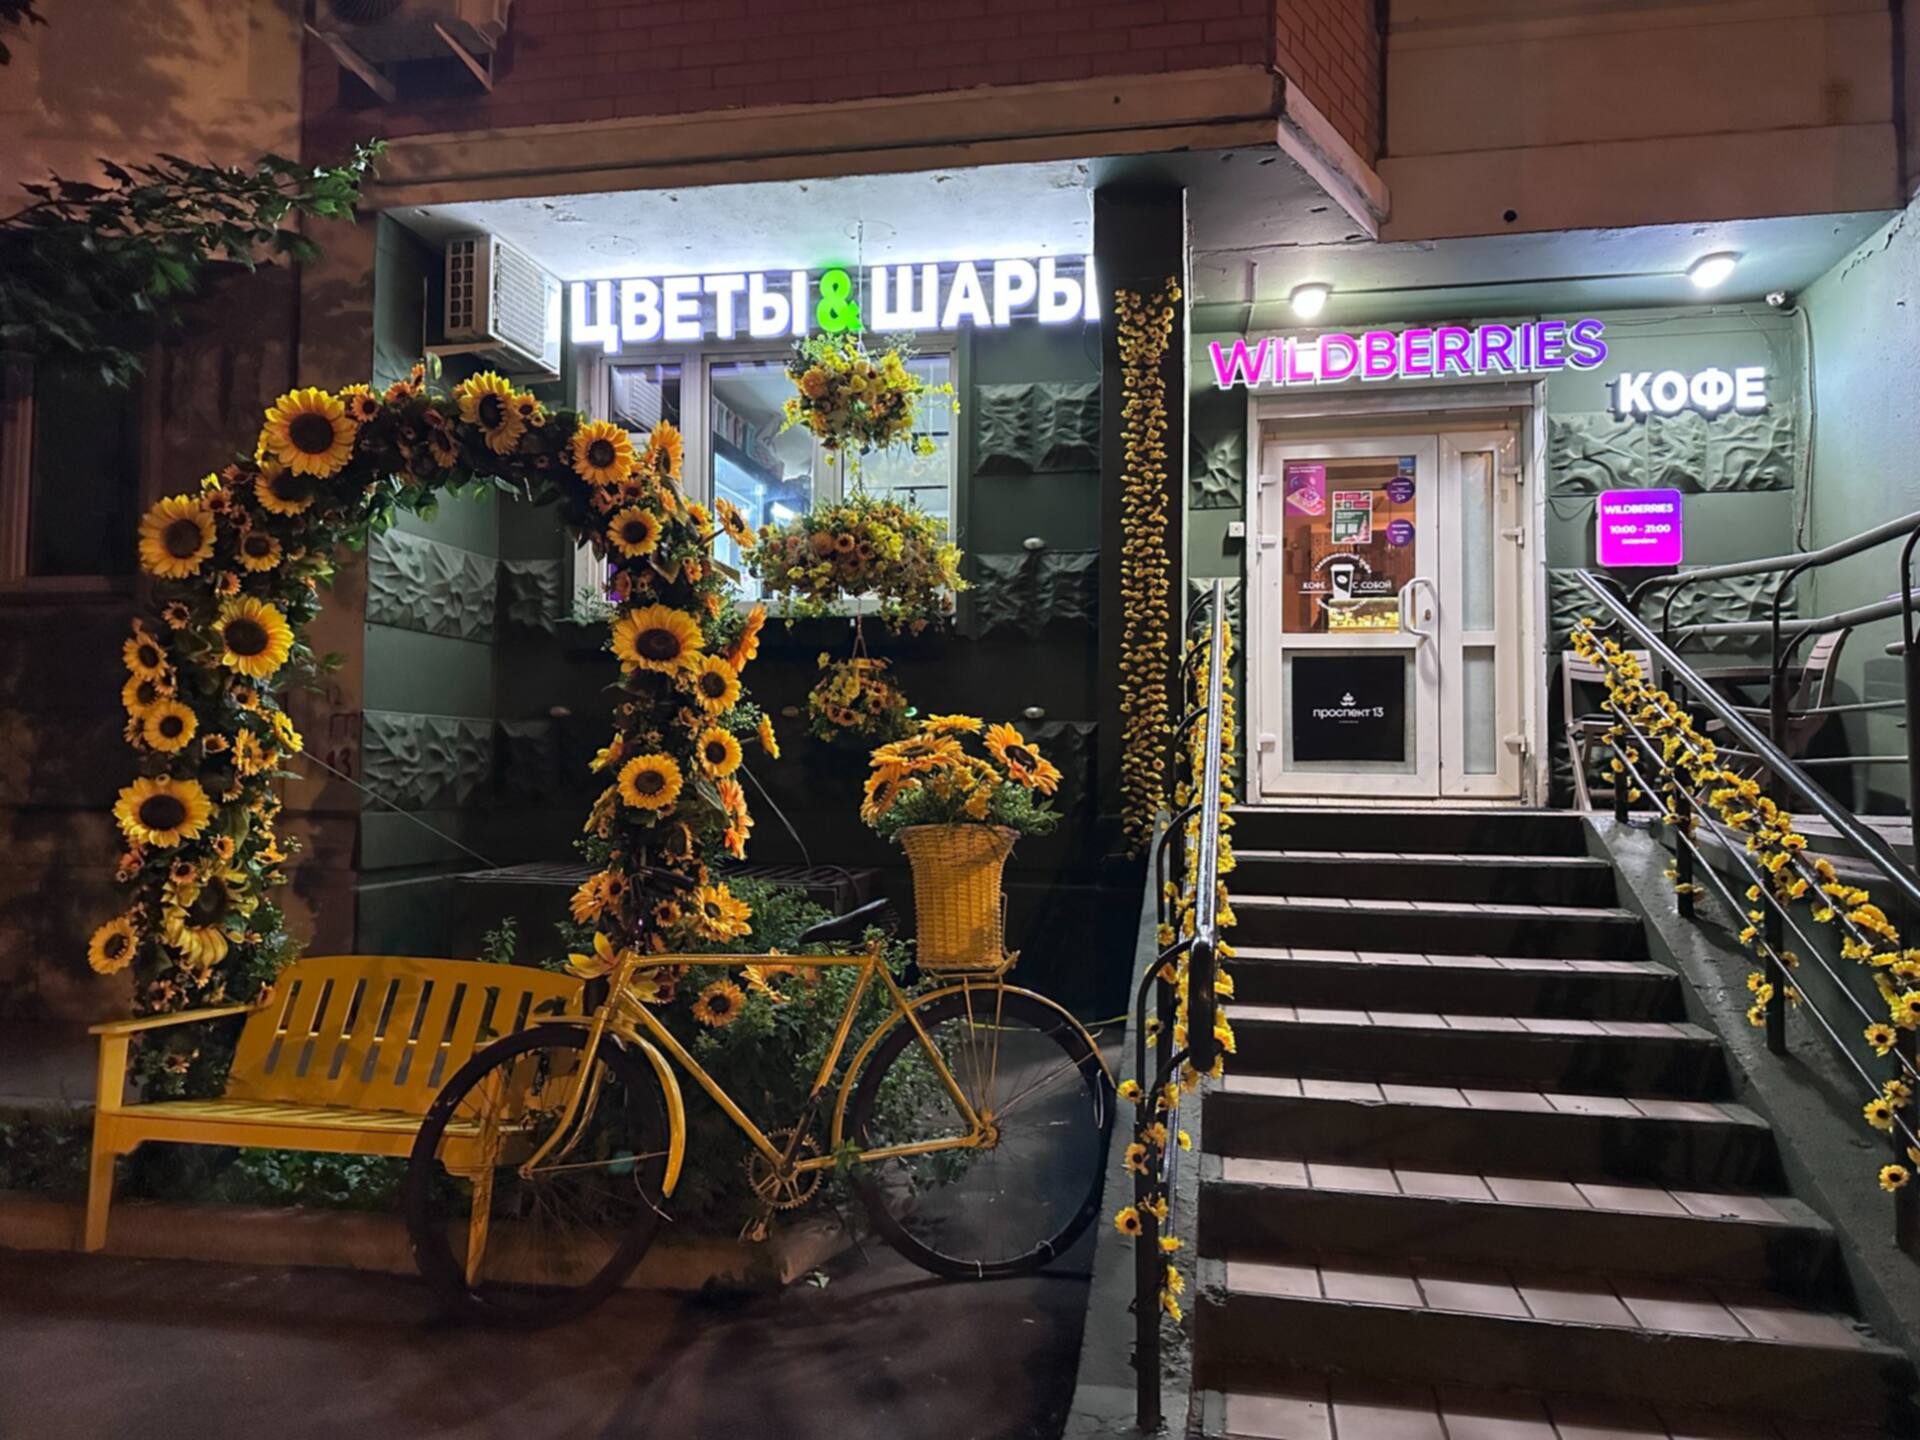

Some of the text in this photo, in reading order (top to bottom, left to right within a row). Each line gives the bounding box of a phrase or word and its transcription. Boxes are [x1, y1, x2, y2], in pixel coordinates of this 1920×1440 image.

[570, 269, 808, 354] ЦВЕТЫ
[870, 255, 1101, 332] ШАРЫ
[1208, 318, 1608, 390] WILDBERRIES
[1618, 366, 1767, 414] КОФЕ
[1604, 503, 1674, 515] WILDBERRIES
[1609, 525, 1637, 534] 10:00
[1644, 523, 1671, 533] 21:00
[1312, 706, 1384, 720] проспект 13
